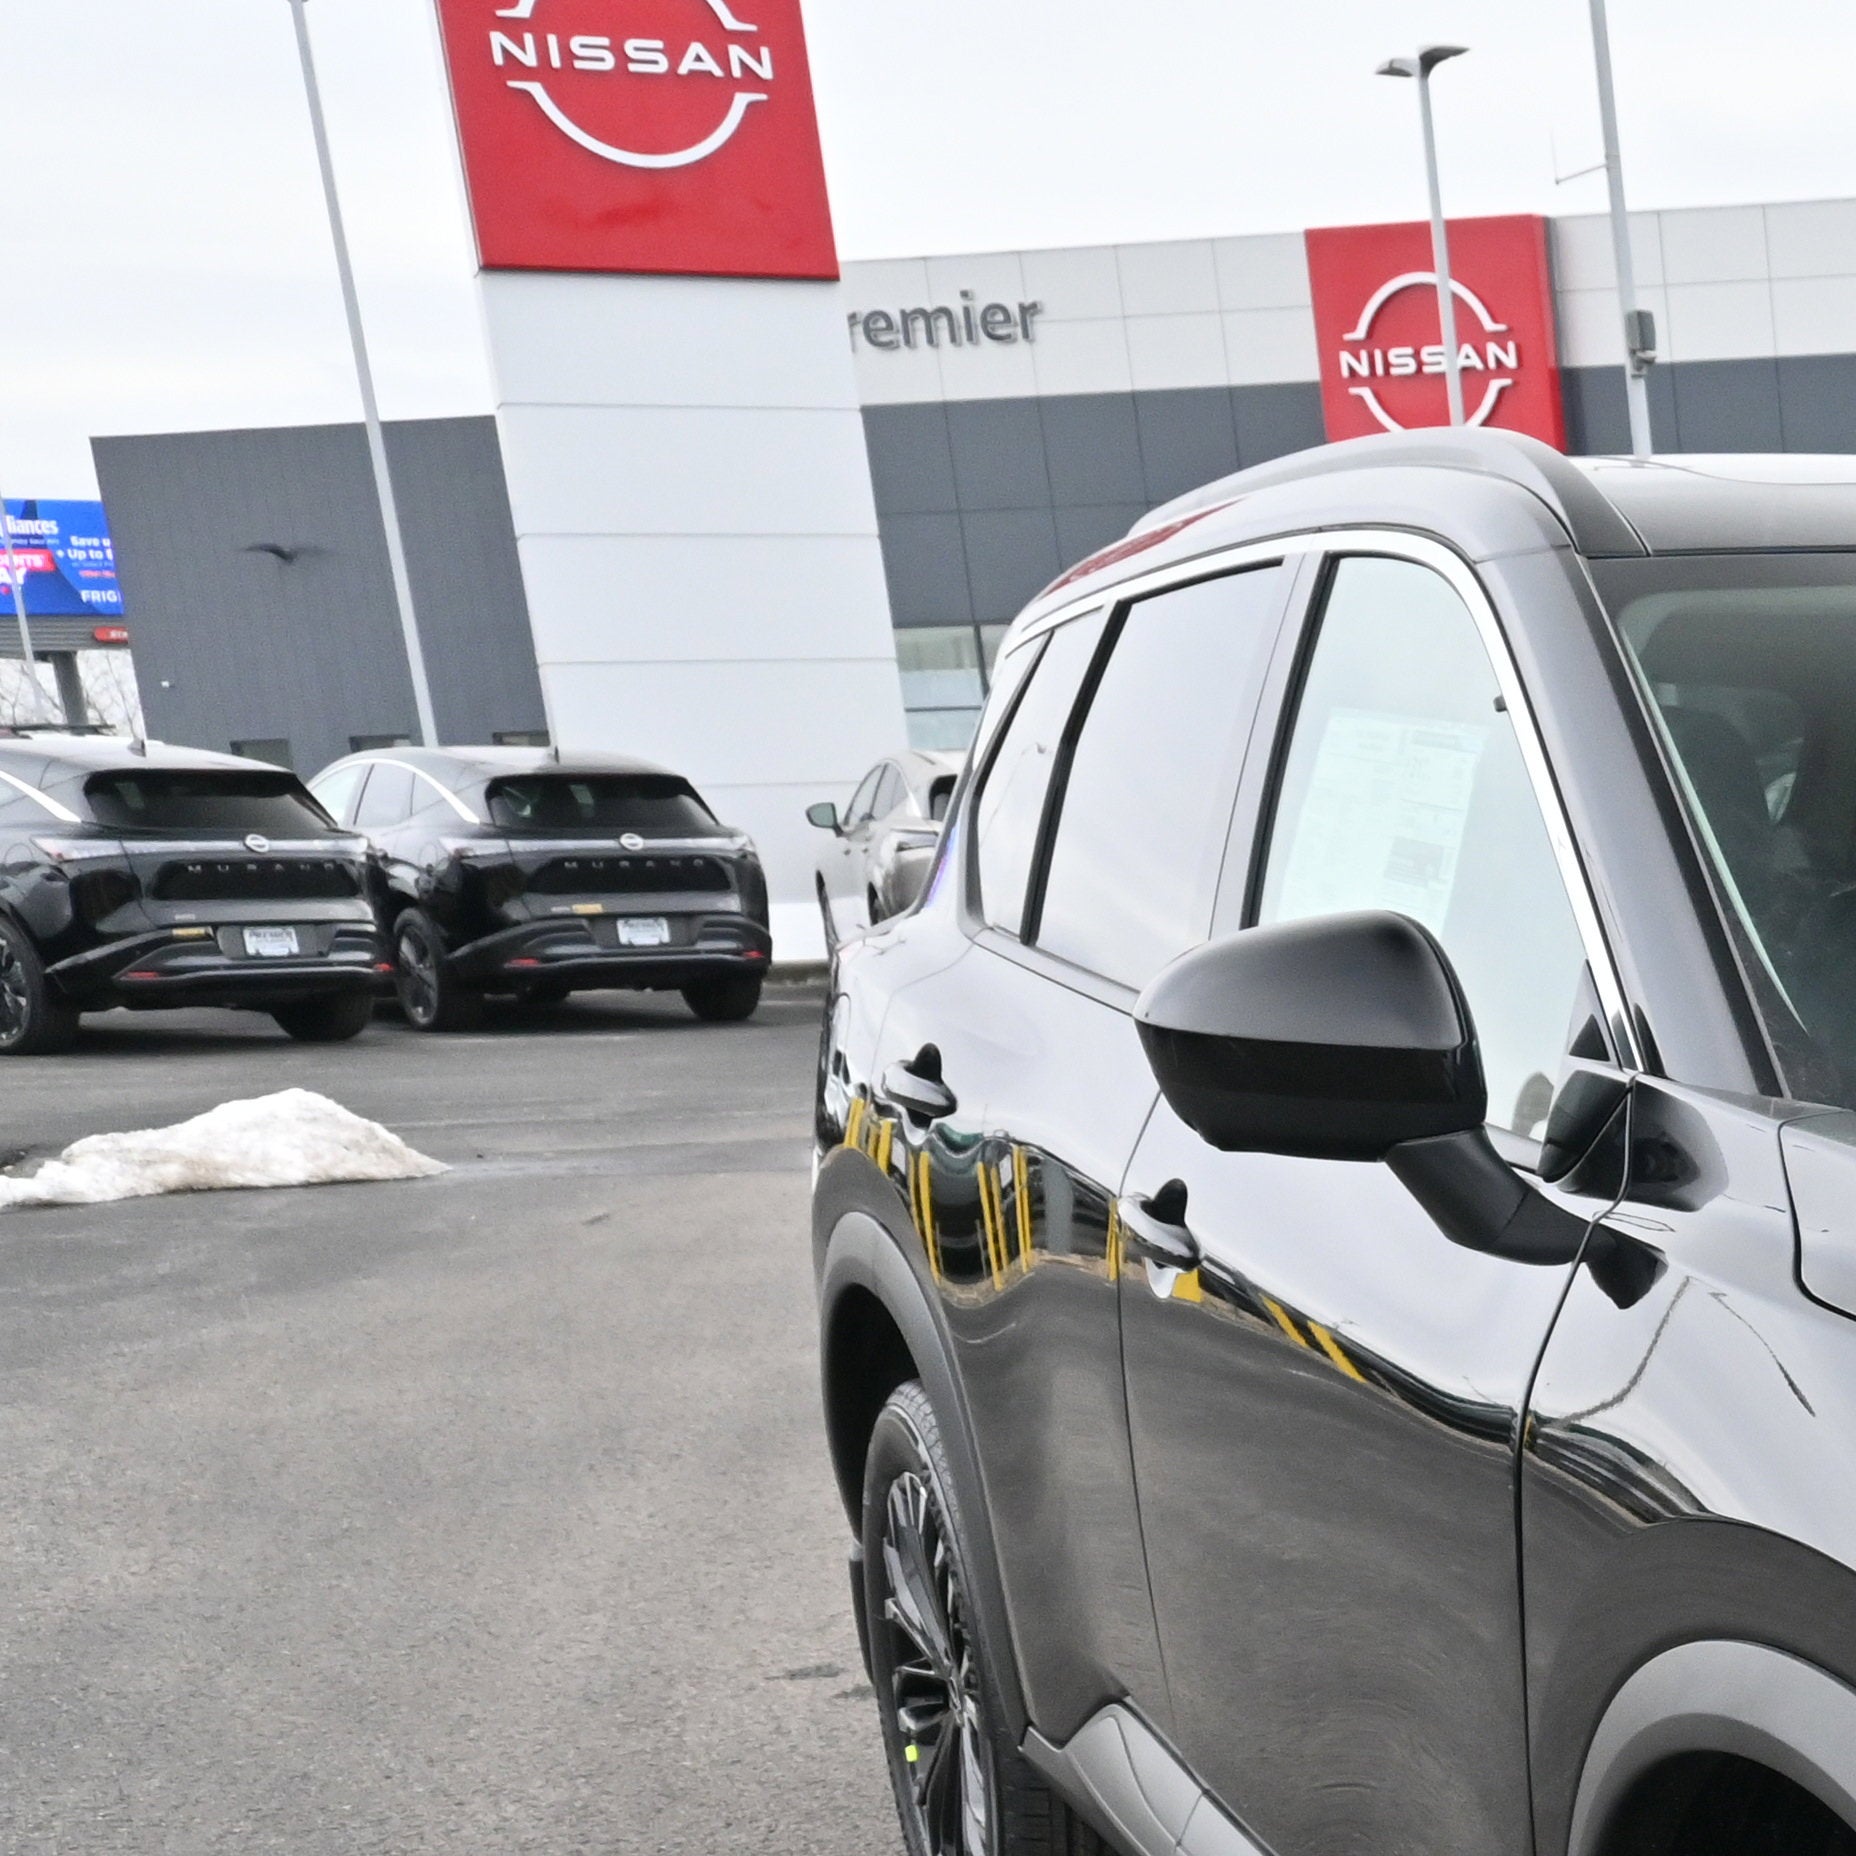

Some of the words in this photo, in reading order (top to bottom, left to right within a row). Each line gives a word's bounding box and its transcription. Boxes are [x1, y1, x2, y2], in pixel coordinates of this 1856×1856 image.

[489, 31, 773, 80] NISSAN
[847, 289, 1042, 350] remier
[1339, 340, 1518, 379] NISSAN
[88, 549, 104, 560] to
